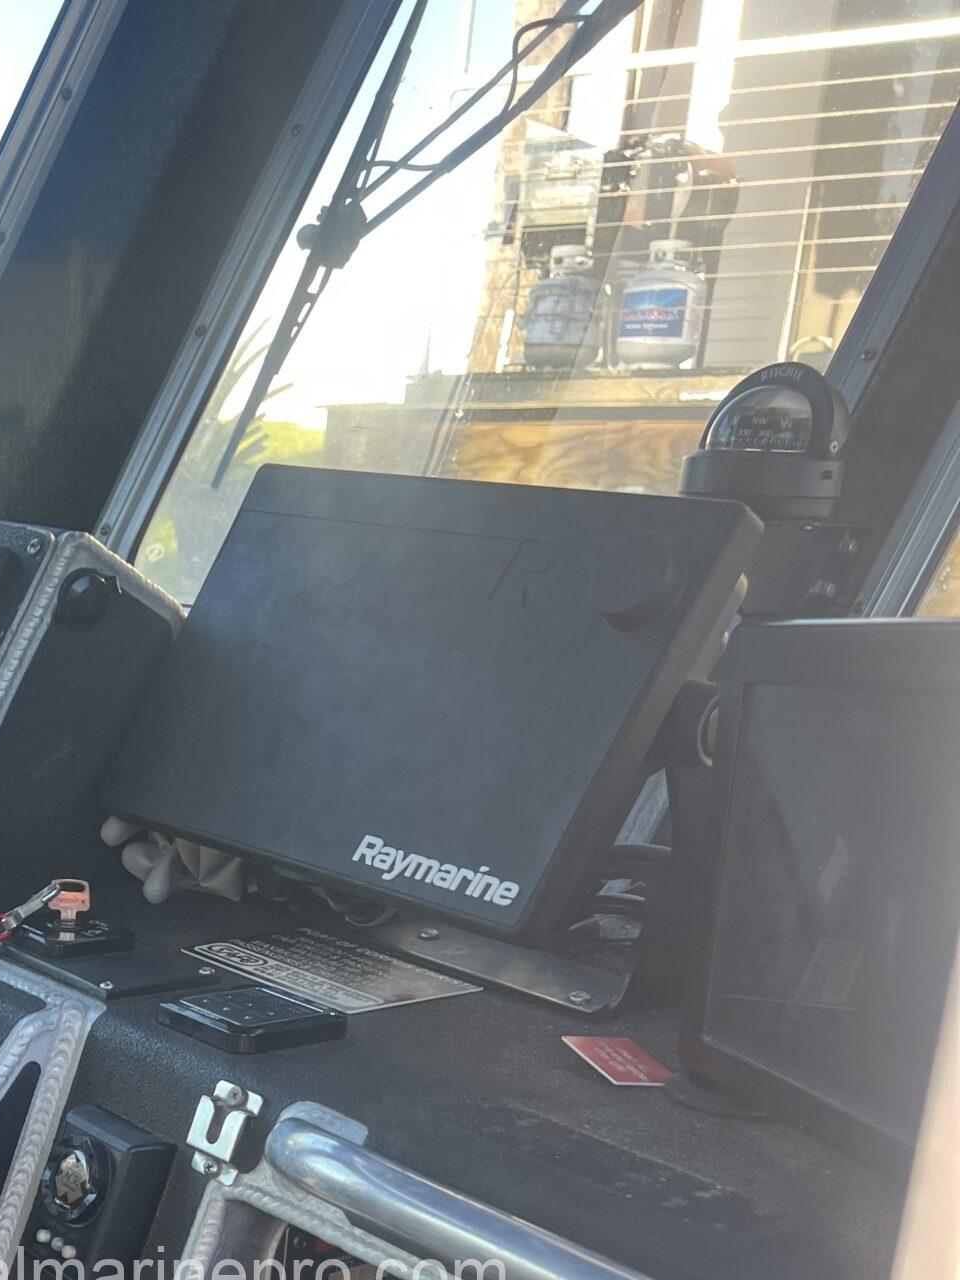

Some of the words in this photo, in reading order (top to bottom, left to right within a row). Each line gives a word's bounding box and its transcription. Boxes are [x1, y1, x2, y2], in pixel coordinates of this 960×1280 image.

[761, 366, 804, 382] RITCHIE
[780, 418, 793, 429] W
[351, 834, 520, 906] Raymarine
